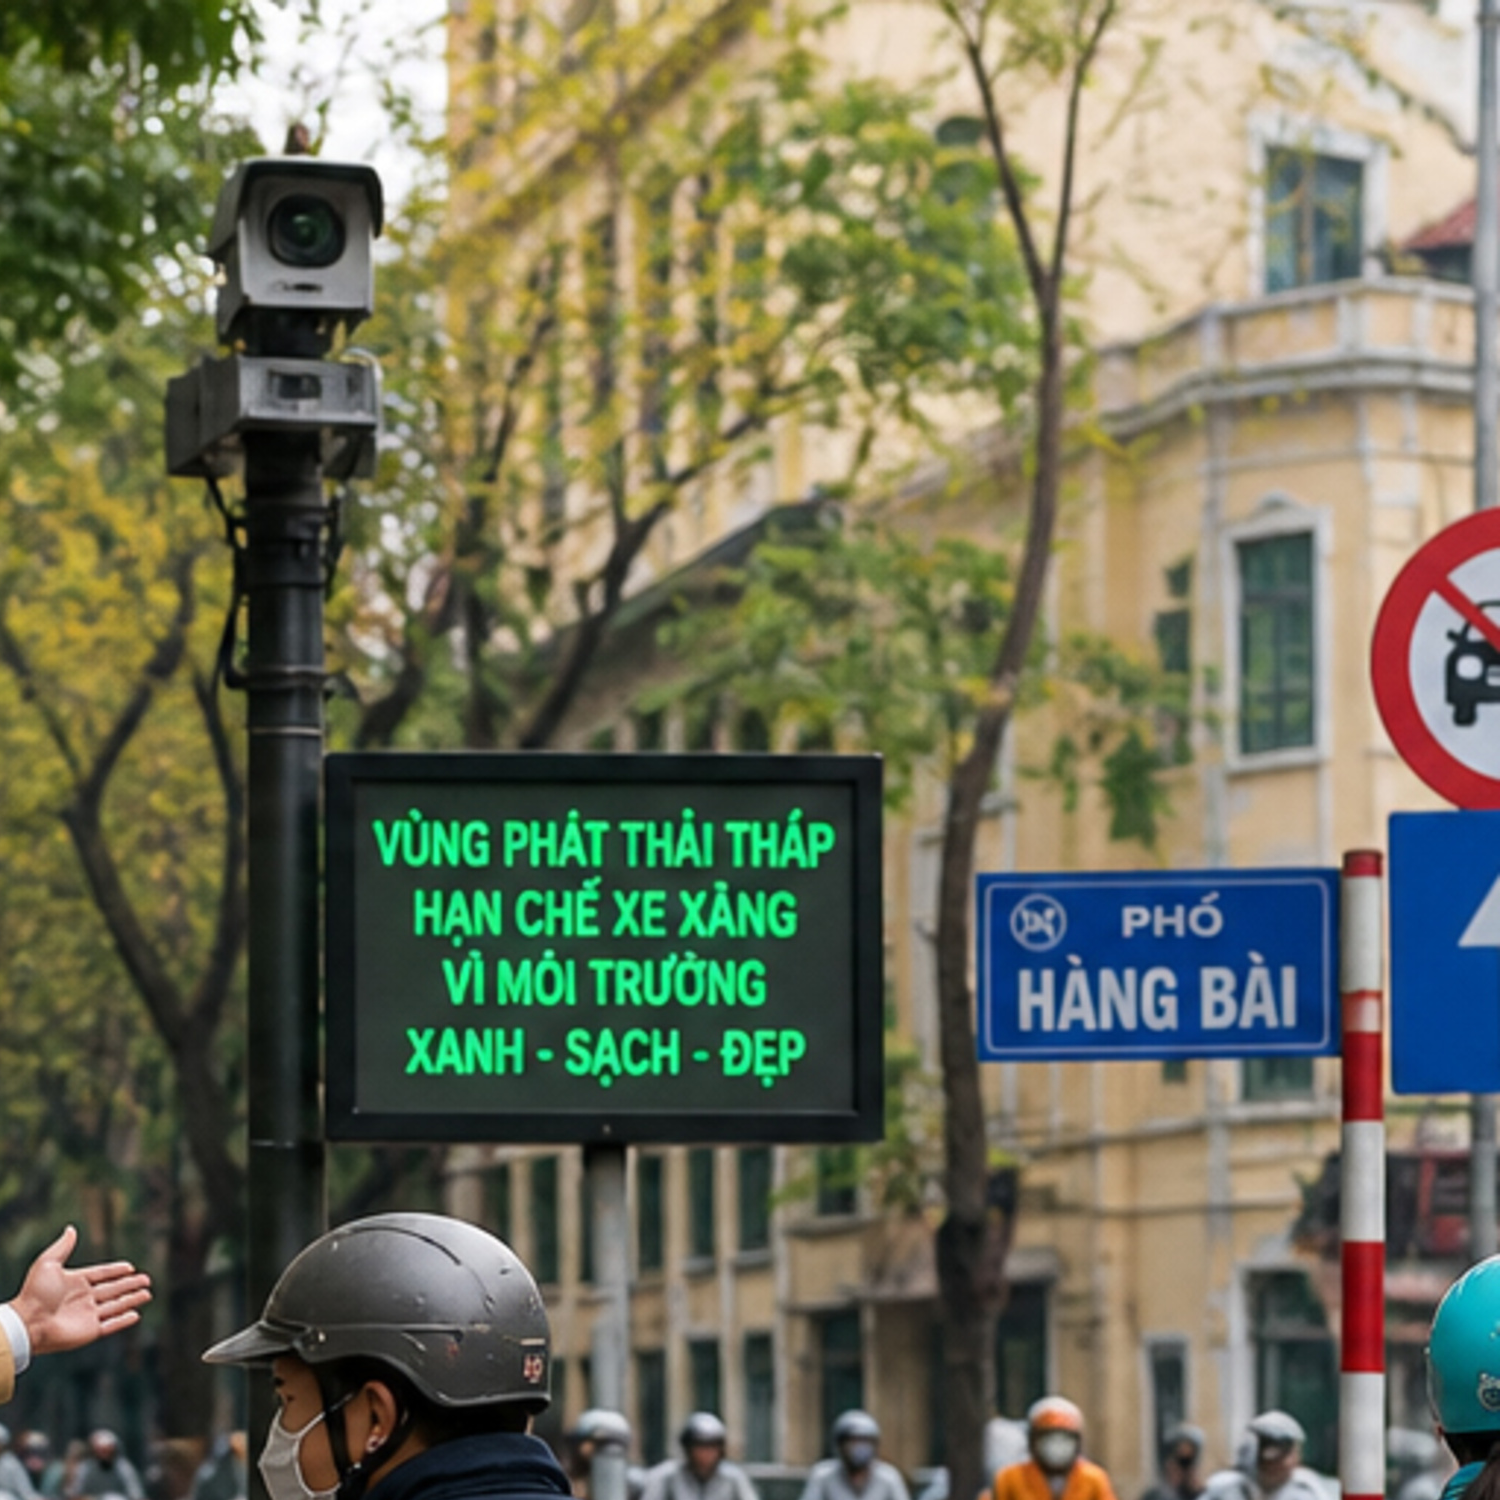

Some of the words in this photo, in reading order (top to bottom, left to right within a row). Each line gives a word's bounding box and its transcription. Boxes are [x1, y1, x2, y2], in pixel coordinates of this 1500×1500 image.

[414, 889, 503, 948] HẠN
[515, 875, 602, 938] CHẾ
[612, 889, 667, 937] XE
[441, 949, 485, 1006] VÌ
[1018, 953, 1179, 1031] HÀNG
[1200, 951, 1297, 1030] BÀI
[405, 1027, 524, 1075] XANH
[536, 1048, 554, 1062] -
[564, 1027, 680, 1088] SẠCH
[692, 1050, 710, 1062] -
[719, 1029, 808, 1088] ĐẸP
